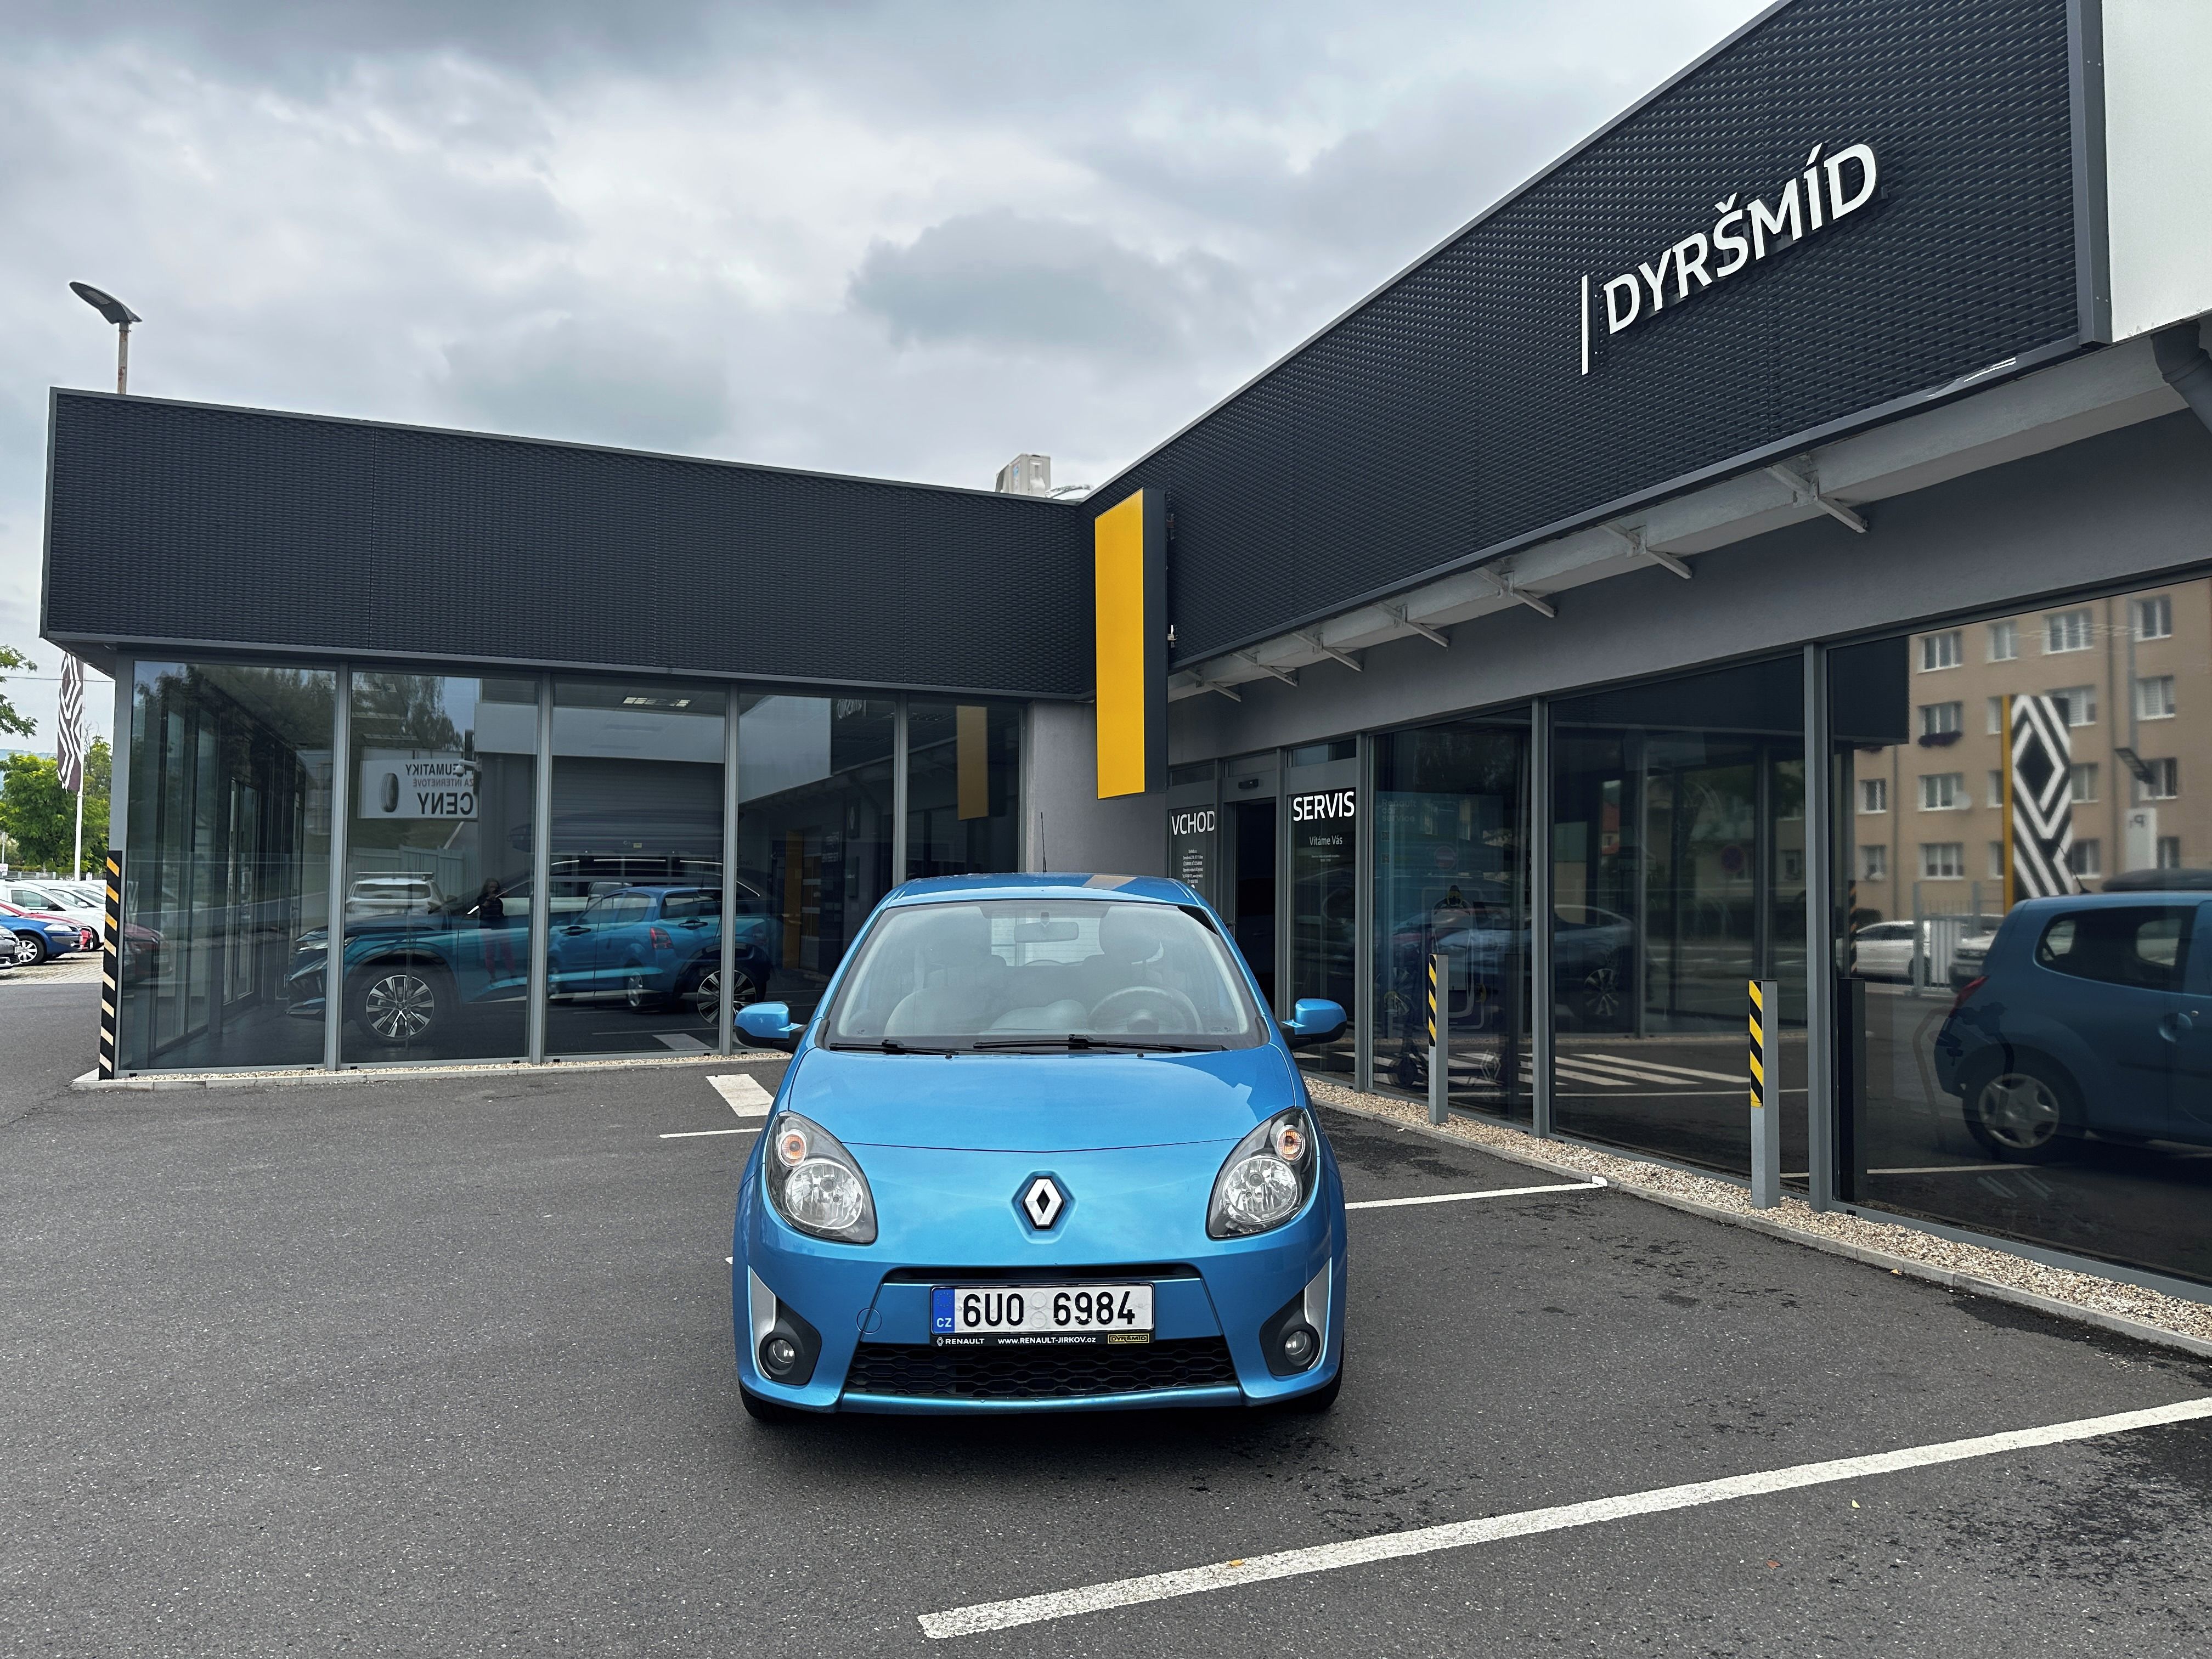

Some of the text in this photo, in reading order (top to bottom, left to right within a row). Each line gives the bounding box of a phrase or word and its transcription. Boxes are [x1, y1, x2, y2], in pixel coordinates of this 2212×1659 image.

[1603, 143, 1877, 334] DYRŠMÍD
[1293, 791, 1355, 821] SERVIS
[1171, 810, 1215, 835] VCHOD
[1331, 834, 1342, 845] Vás
[936, 1317, 952, 1328] CZ
[963, 1291, 1135, 1327] 6U0 6984
